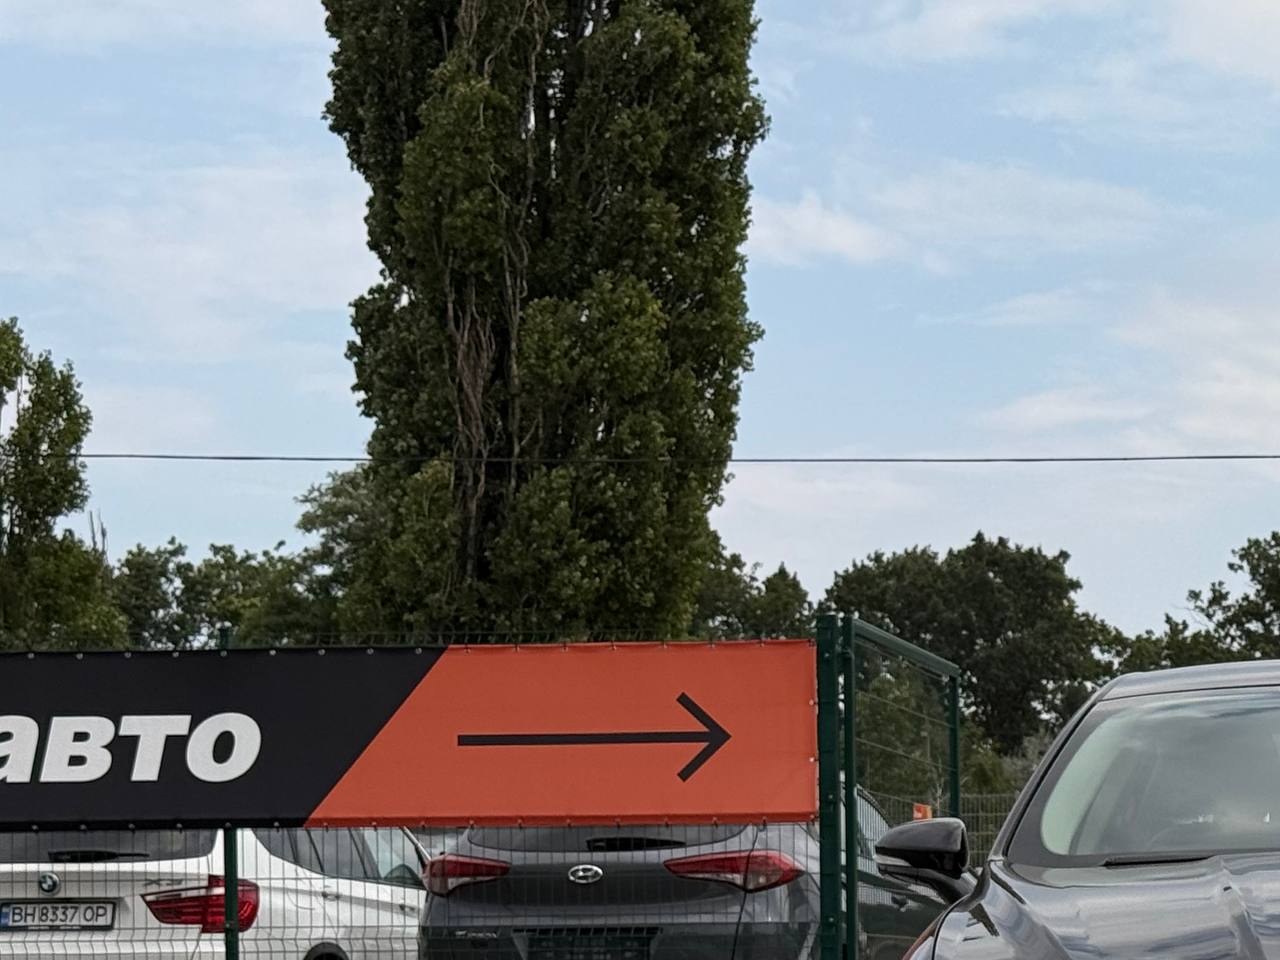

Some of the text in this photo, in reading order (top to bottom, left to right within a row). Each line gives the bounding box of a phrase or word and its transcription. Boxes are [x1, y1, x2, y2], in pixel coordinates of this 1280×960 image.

[0, 712, 262, 783] авто
[11, 905, 36, 923] BH
[39, 905, 79, 923] 8337
